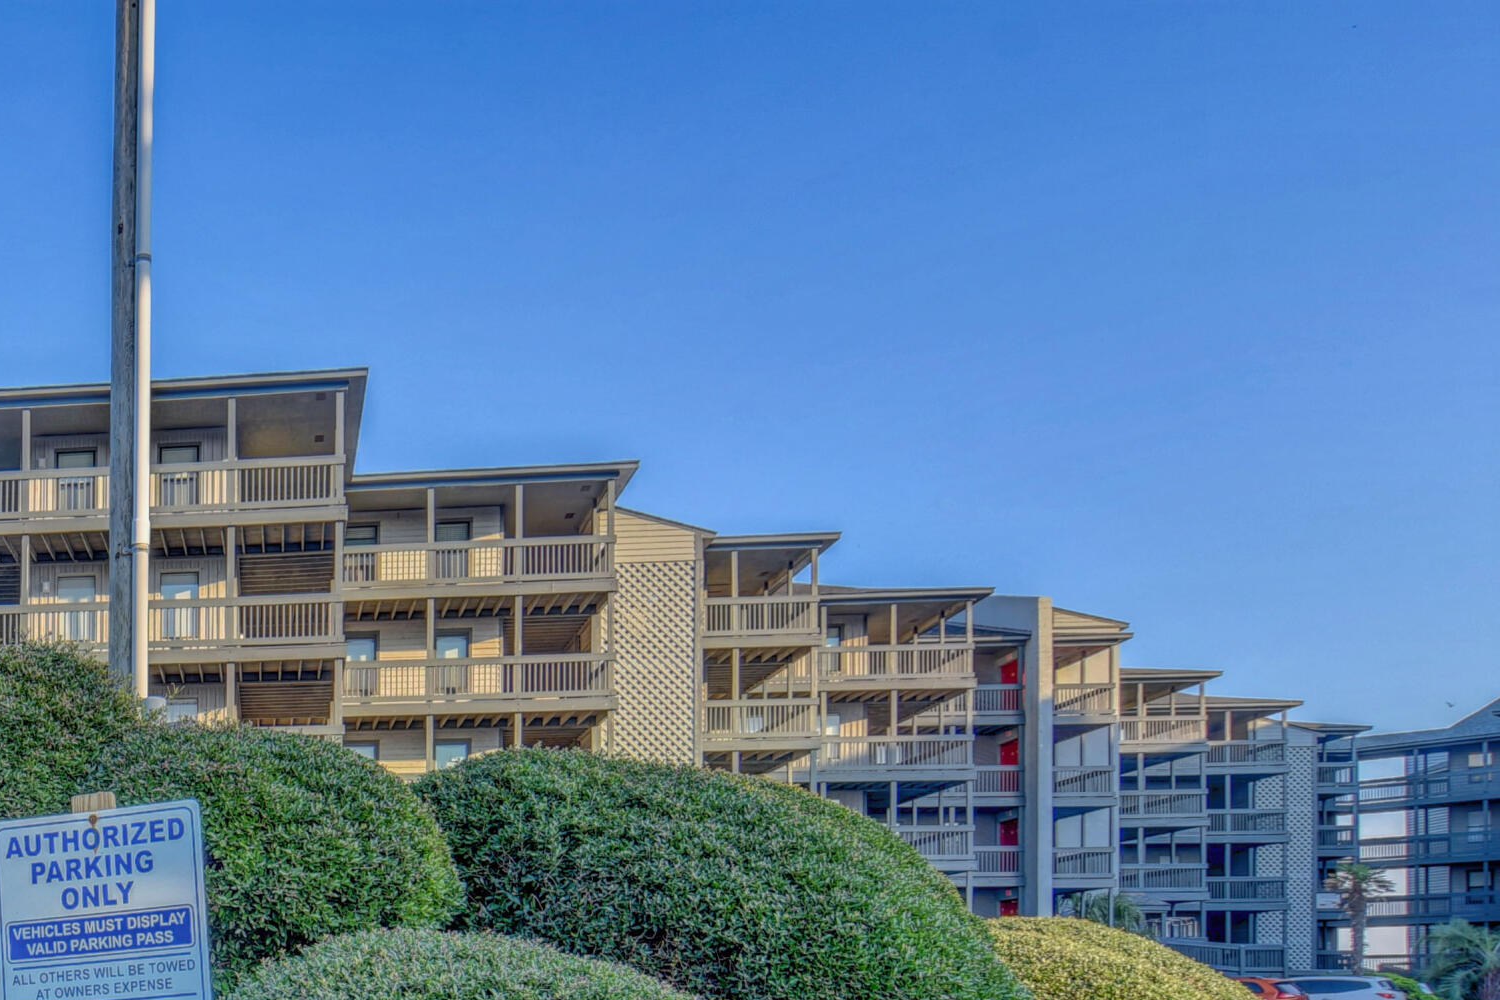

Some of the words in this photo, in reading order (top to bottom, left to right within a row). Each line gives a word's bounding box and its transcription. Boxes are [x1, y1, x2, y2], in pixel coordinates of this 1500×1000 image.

[6, 818, 184, 859] AUTHORIZED
[31, 850, 154, 884] PARKING
[61, 881, 134, 910] ONLY
[13, 923, 81, 940] VEHICLES
[84, 917, 123, 933] MUST
[127, 912, 187, 930] DISPLAY
[26, 941, 67, 956] VALID
[70, 935, 133, 952] PARKING
[136, 931, 174, 945] PASS
[13, 973, 36, 986] ALL
[40, 969, 90, 983] OTHERS
[94, 966, 124, 979] WILL
[128, 964, 145, 976] BE
[149, 959, 196, 974] TOWED
[36, 988, 51, 1000] AT
[55, 984, 109, 999] OWNERS
[114, 978, 173, 993] EXPENSE
